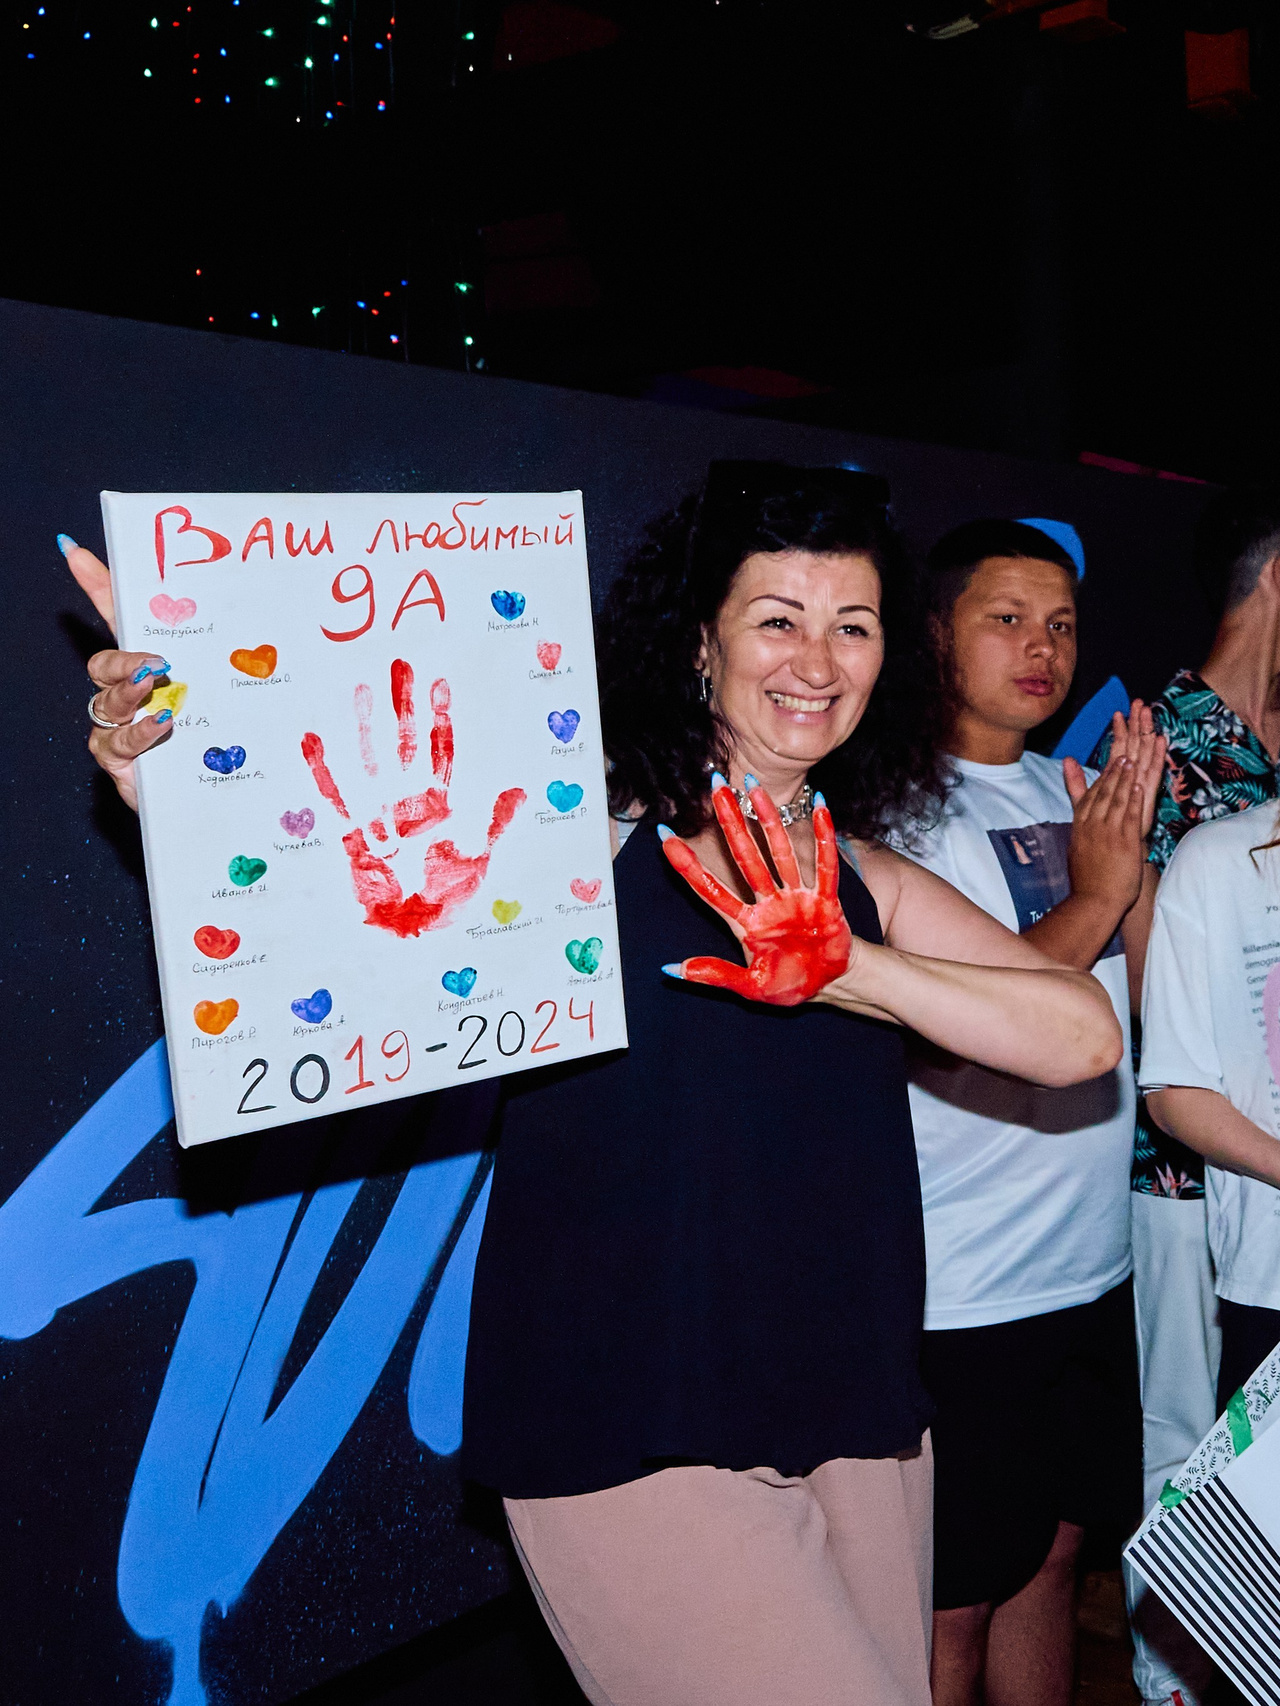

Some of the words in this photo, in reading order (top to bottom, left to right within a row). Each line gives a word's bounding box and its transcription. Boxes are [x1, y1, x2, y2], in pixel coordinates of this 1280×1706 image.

[366, 498, 575, 555] любимый
[143, 625, 204, 638] Загоруйко
[198, 772, 250, 788] Ходанович
[211, 886, 253, 899] Иванов
[192, 954, 257, 977] Сидоренков
[437, 989, 494, 1015] Кондратьев
[292, 1021, 333, 1037] Юркова
[191, 1030, 245, 1049] Пирогов
